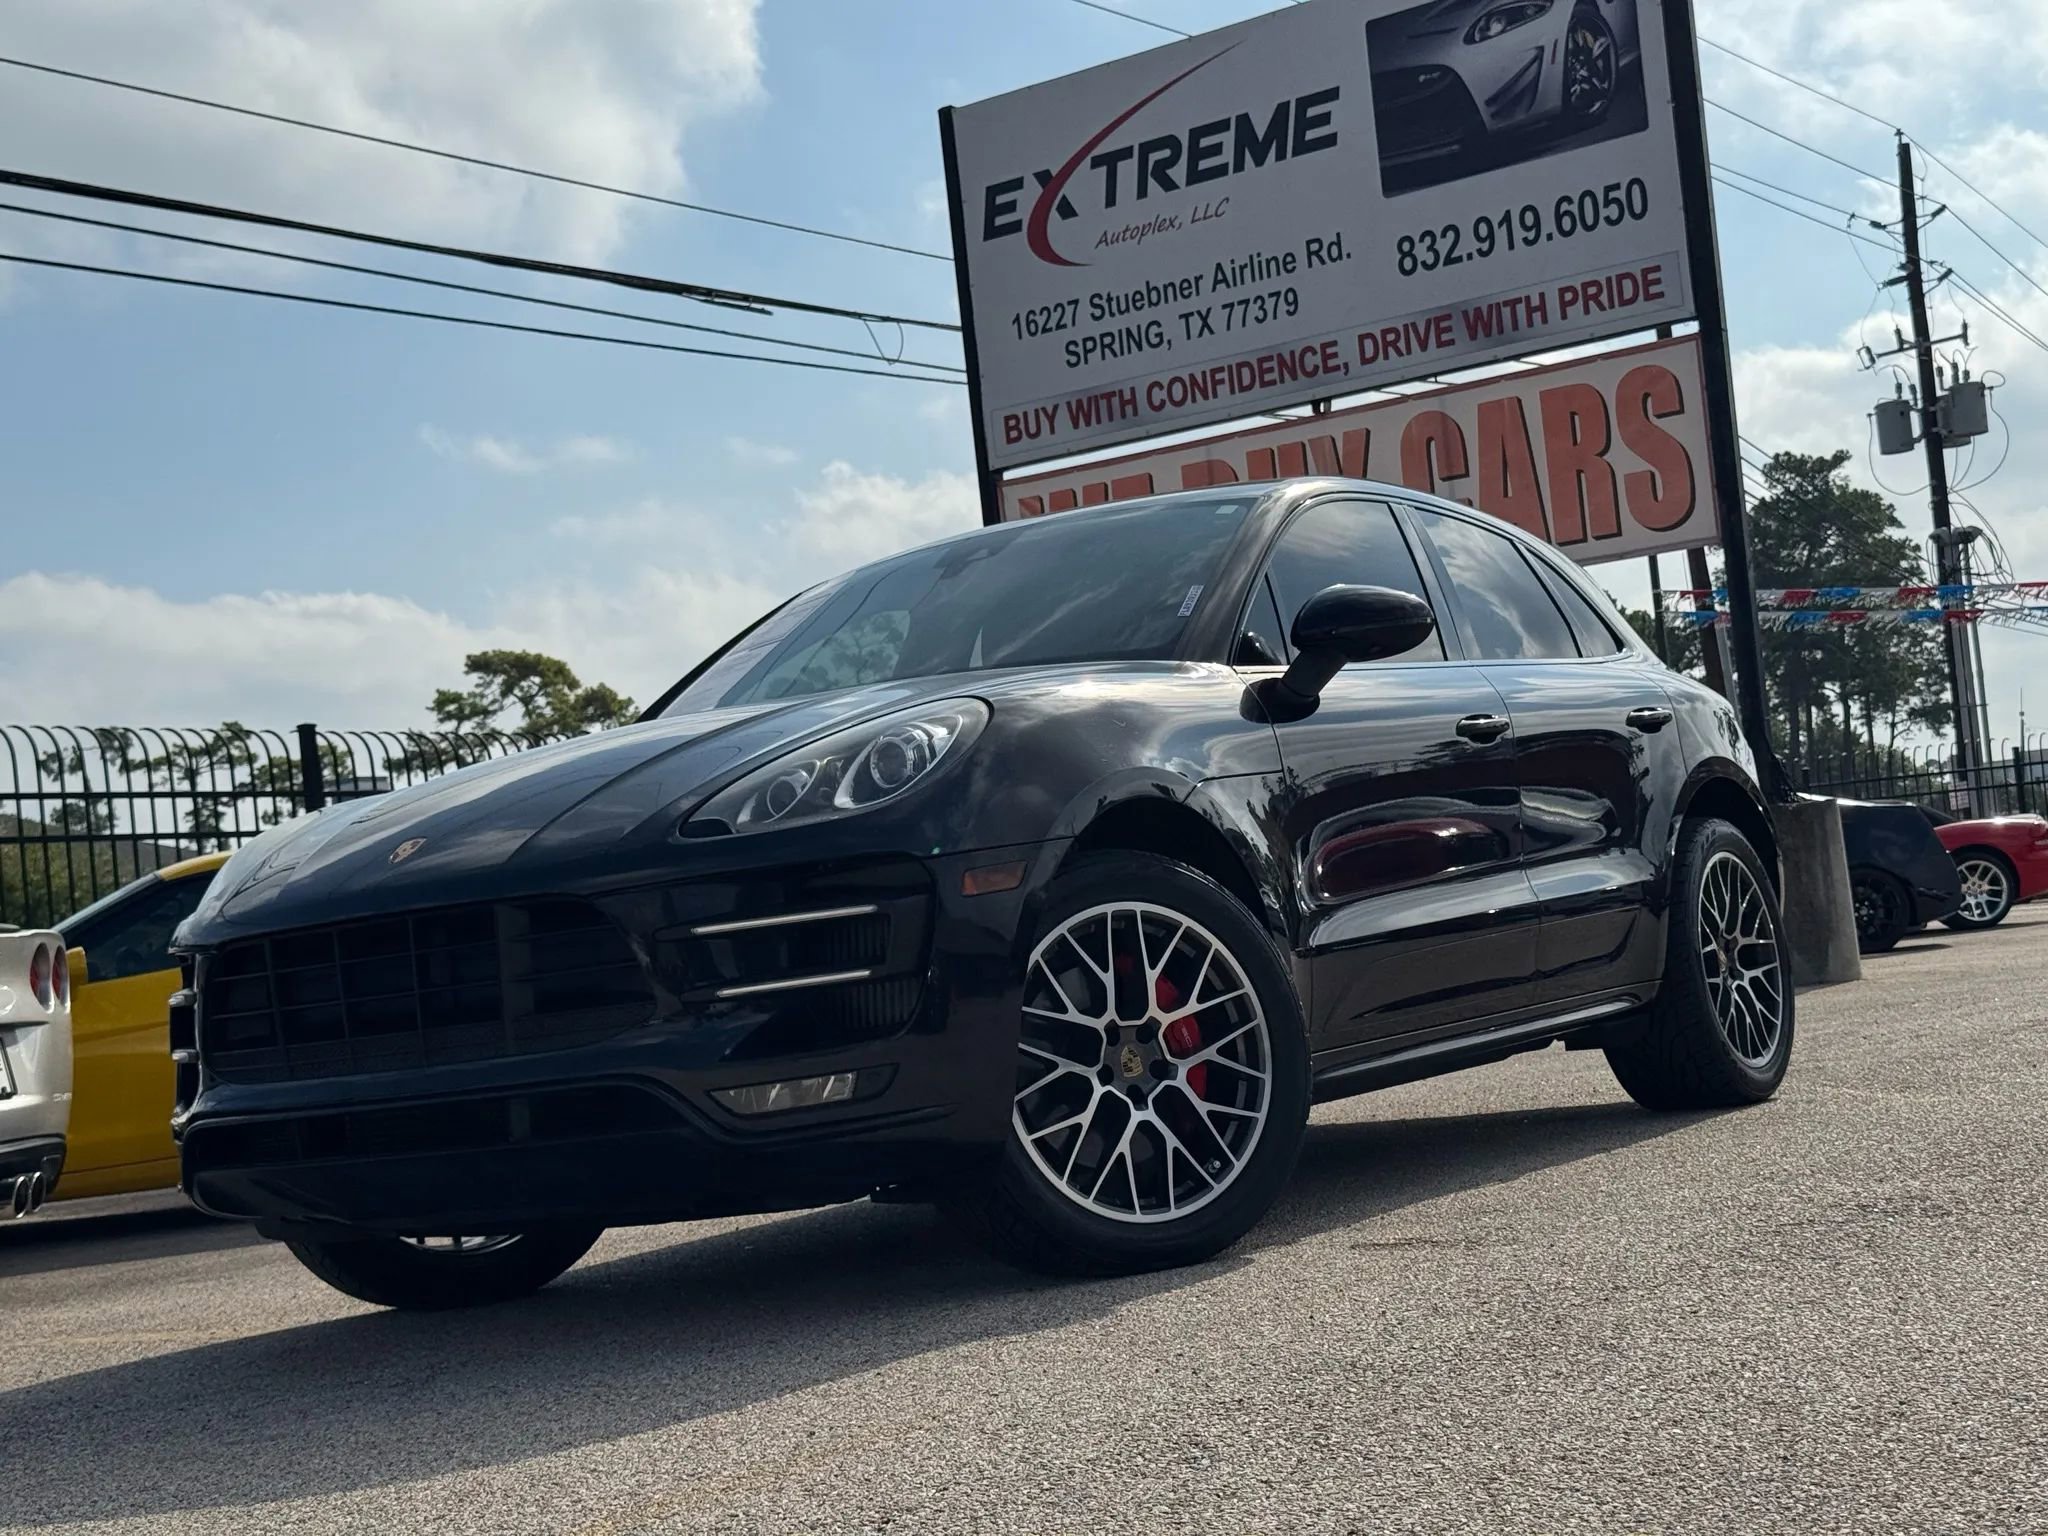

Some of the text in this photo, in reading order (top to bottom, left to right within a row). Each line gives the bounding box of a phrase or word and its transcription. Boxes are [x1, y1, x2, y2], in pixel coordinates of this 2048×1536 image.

[983, 86, 1340, 243] EXTREME
[1094, 197, 1230, 250] Autoplex, LLC
[1396, 177, 1648, 277] 832.919.6050
[1012, 232, 1352, 340] 16227 Stuebner Airline Rd.
[1065, 287, 1300, 368] SPRING, TX 77379
[1003, 265, 1665, 445] BUY WITH CONFIDENCE, DRIVE WITH PRIDE
